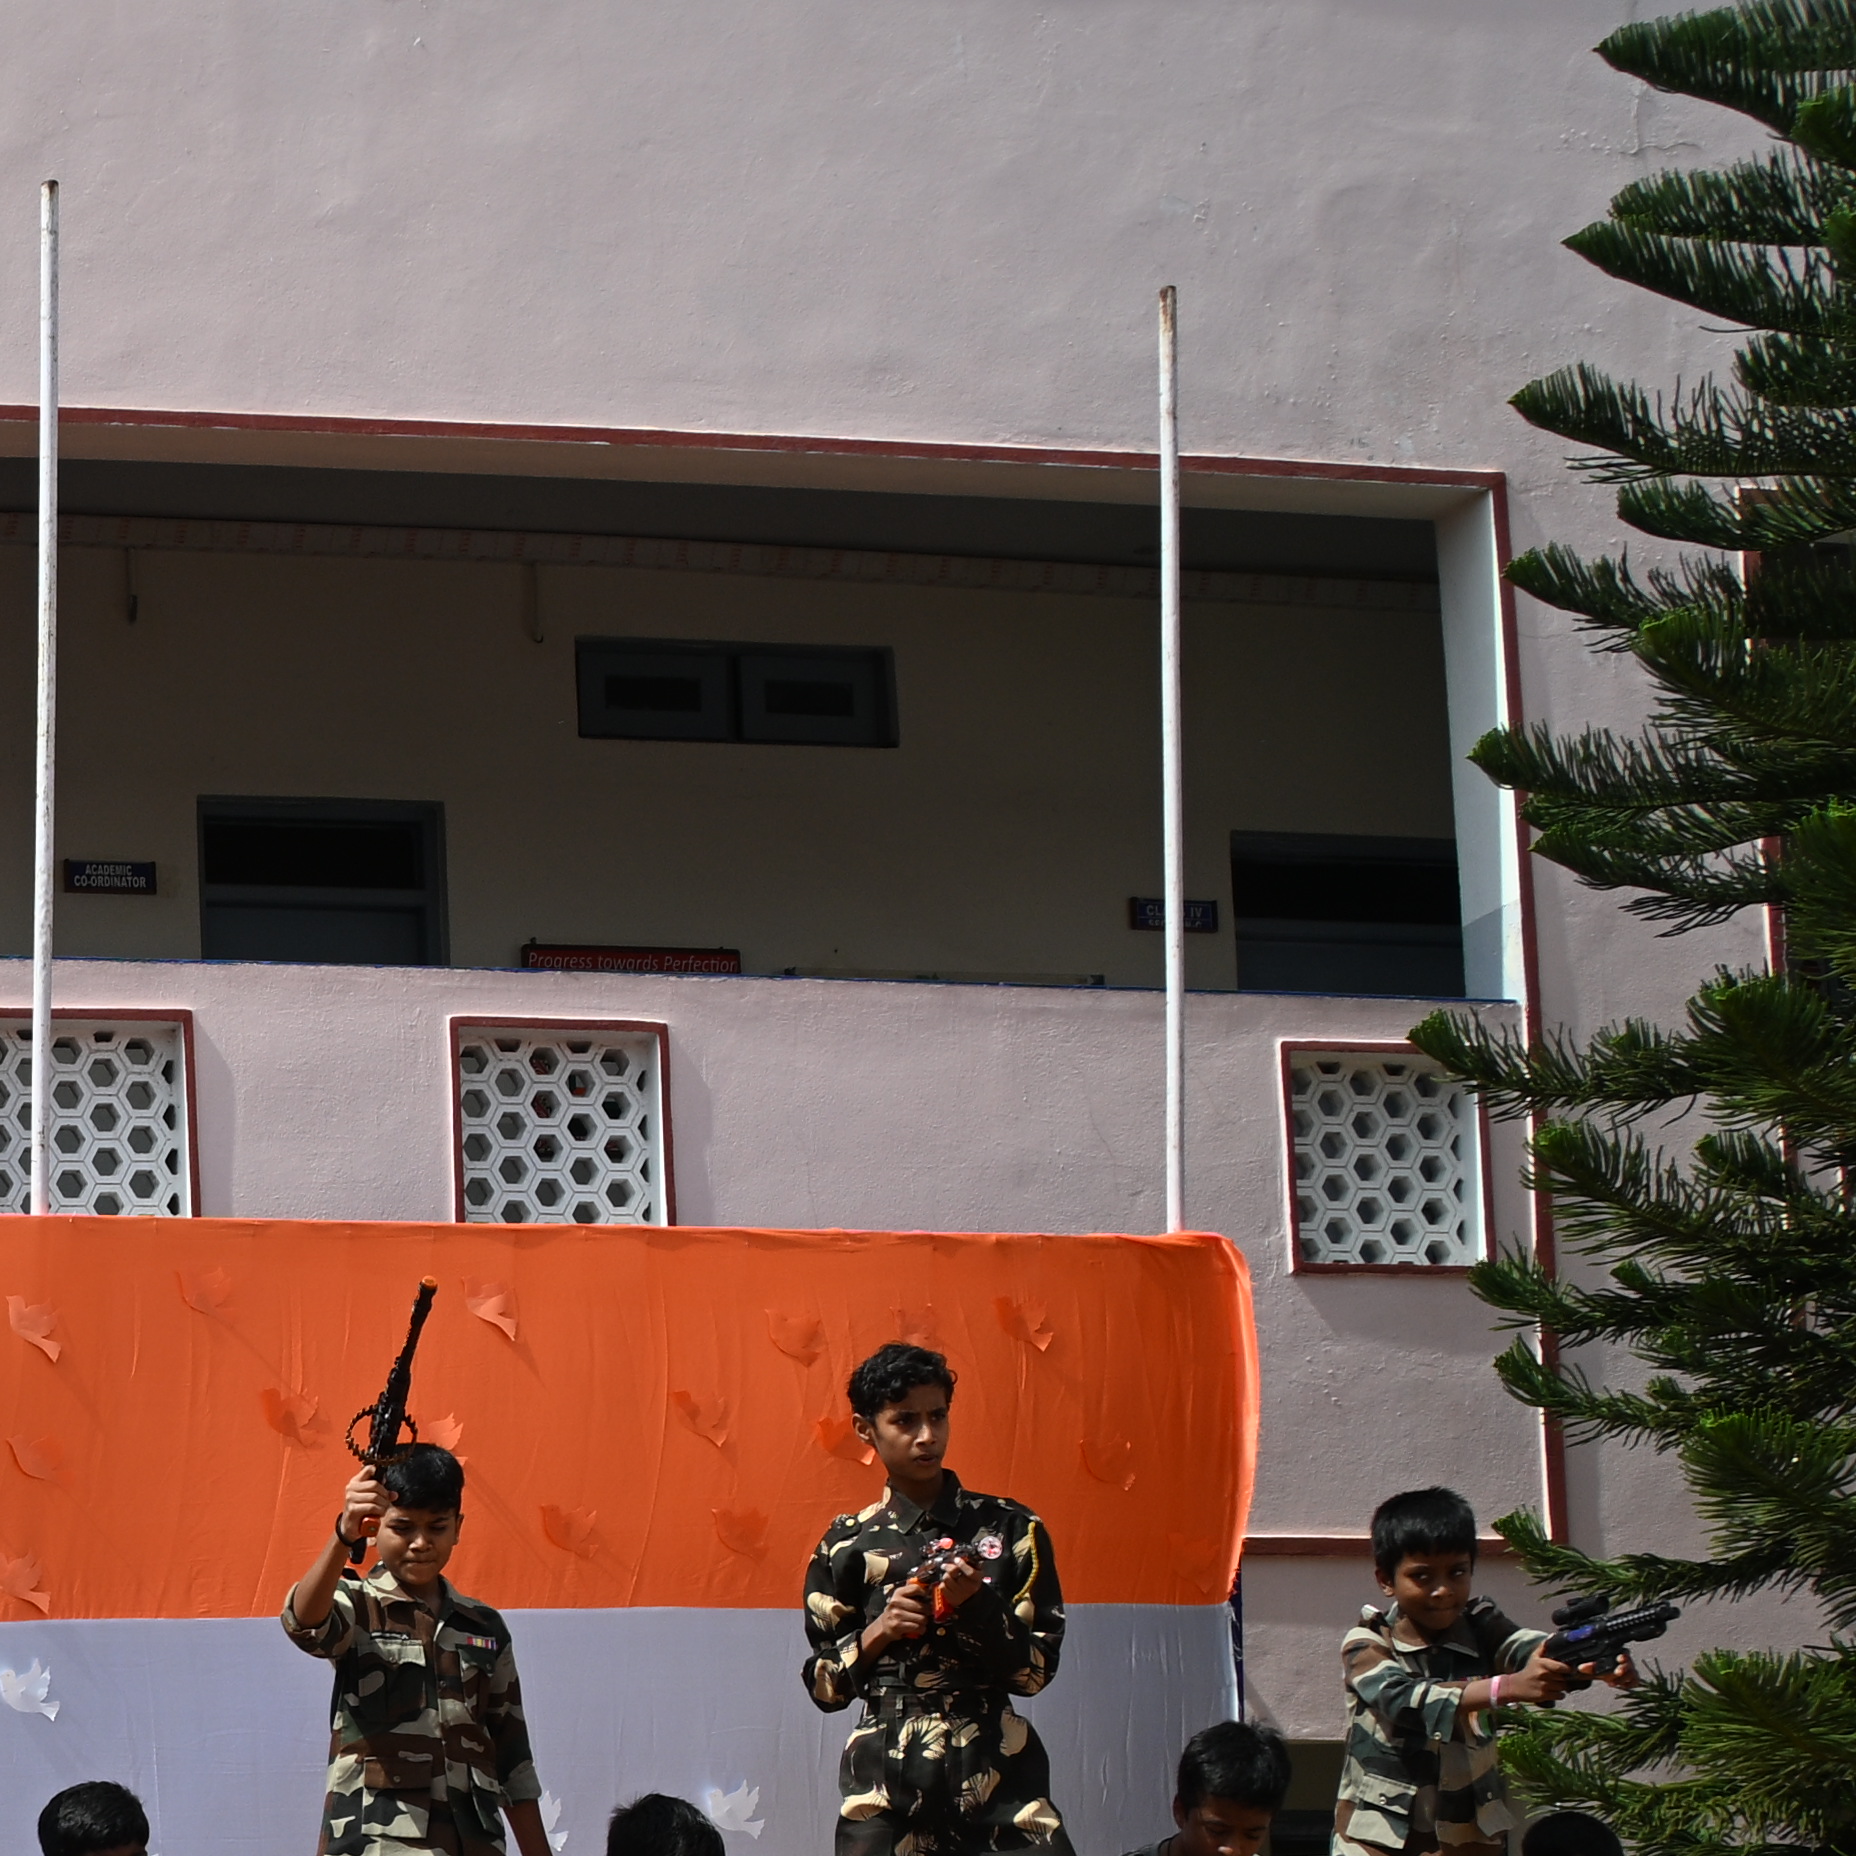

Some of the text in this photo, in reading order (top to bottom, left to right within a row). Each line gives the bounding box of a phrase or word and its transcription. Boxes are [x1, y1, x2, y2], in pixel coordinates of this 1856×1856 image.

[85, 864, 132, 875] ACADEMIC
[74, 875, 147, 888] CO-ORDINATOR
[1190, 907, 1202, 917] IV
[529, 952, 738, 972] Progress towards Perfection
